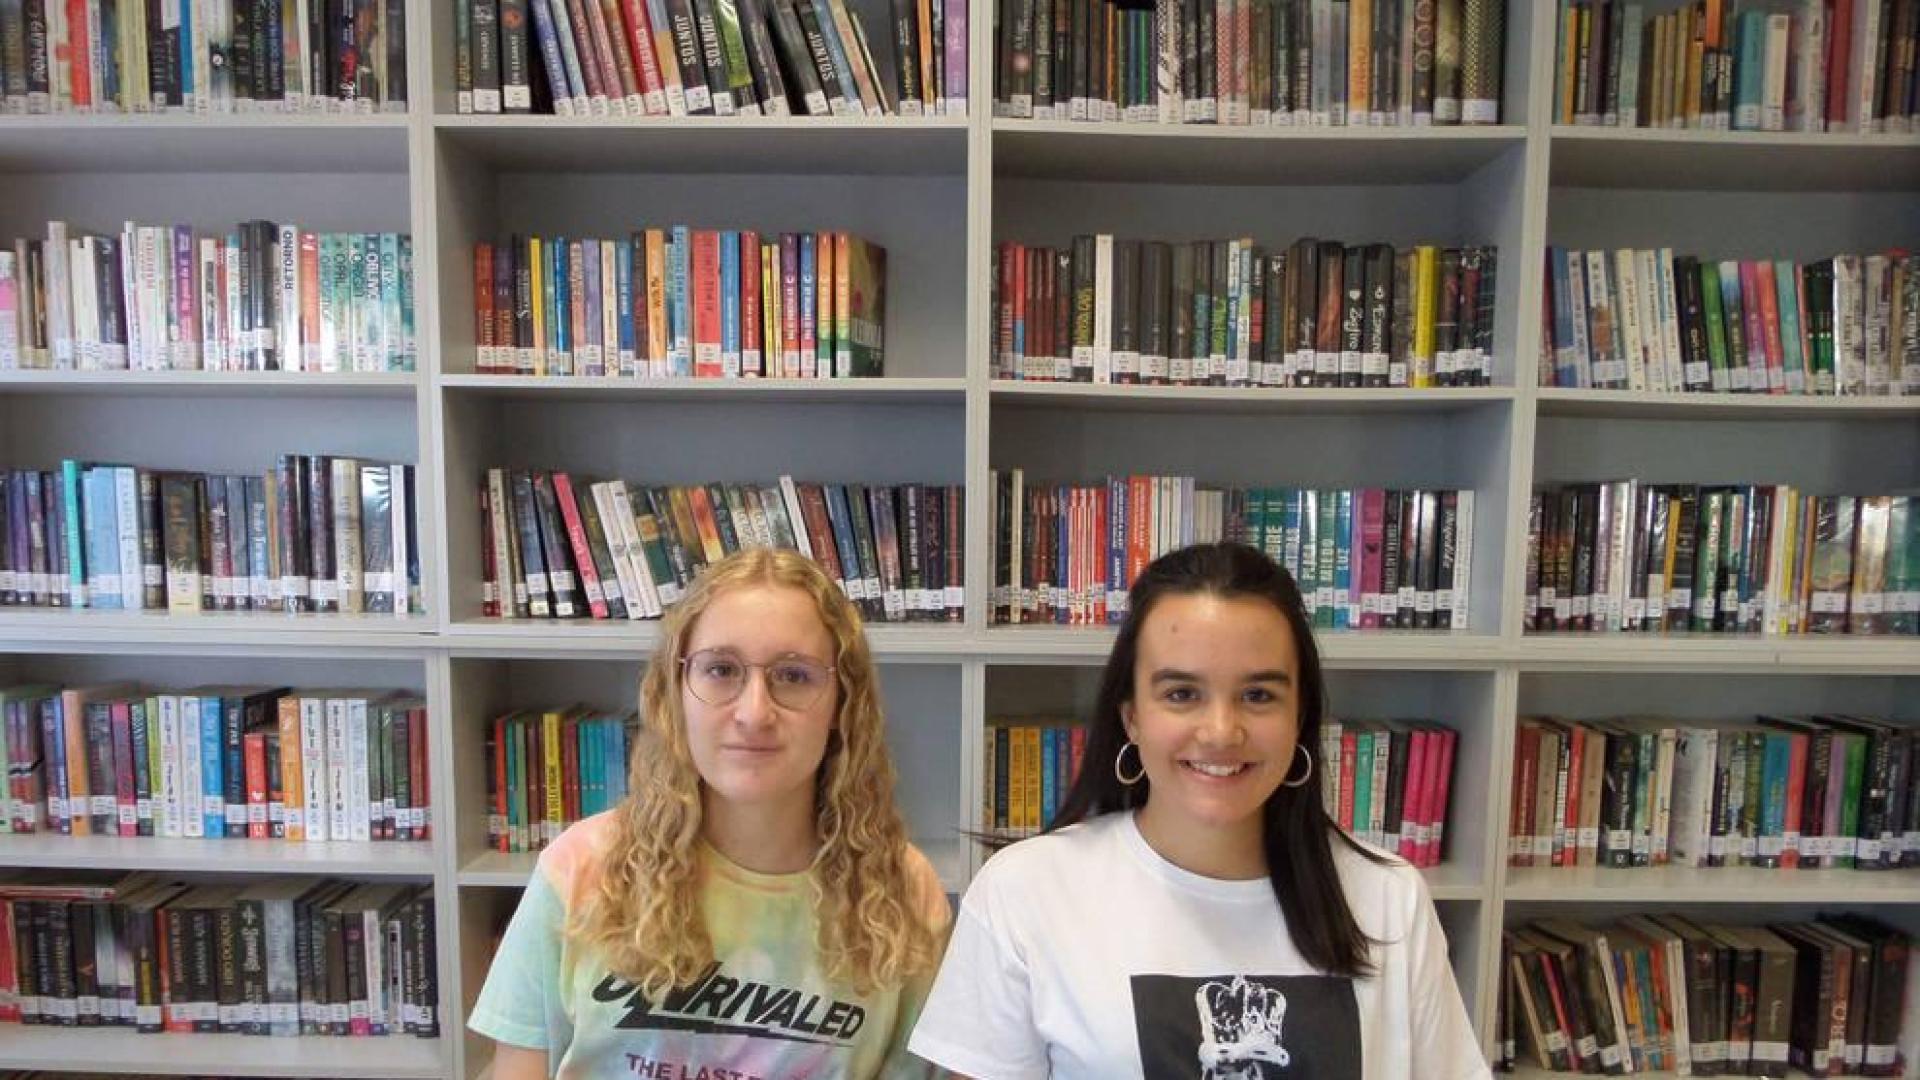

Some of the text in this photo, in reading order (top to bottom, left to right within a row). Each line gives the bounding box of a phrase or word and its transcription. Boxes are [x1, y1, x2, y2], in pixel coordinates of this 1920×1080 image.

[673, 15, 697, 66] JUNTOS
[698, 15, 724, 68] JUNTOS
[807, 32, 837, 83] JUNTOS
[284, 231, 297, 290] RETORNO
[625, 1052, 743, 1080] THE LAST
